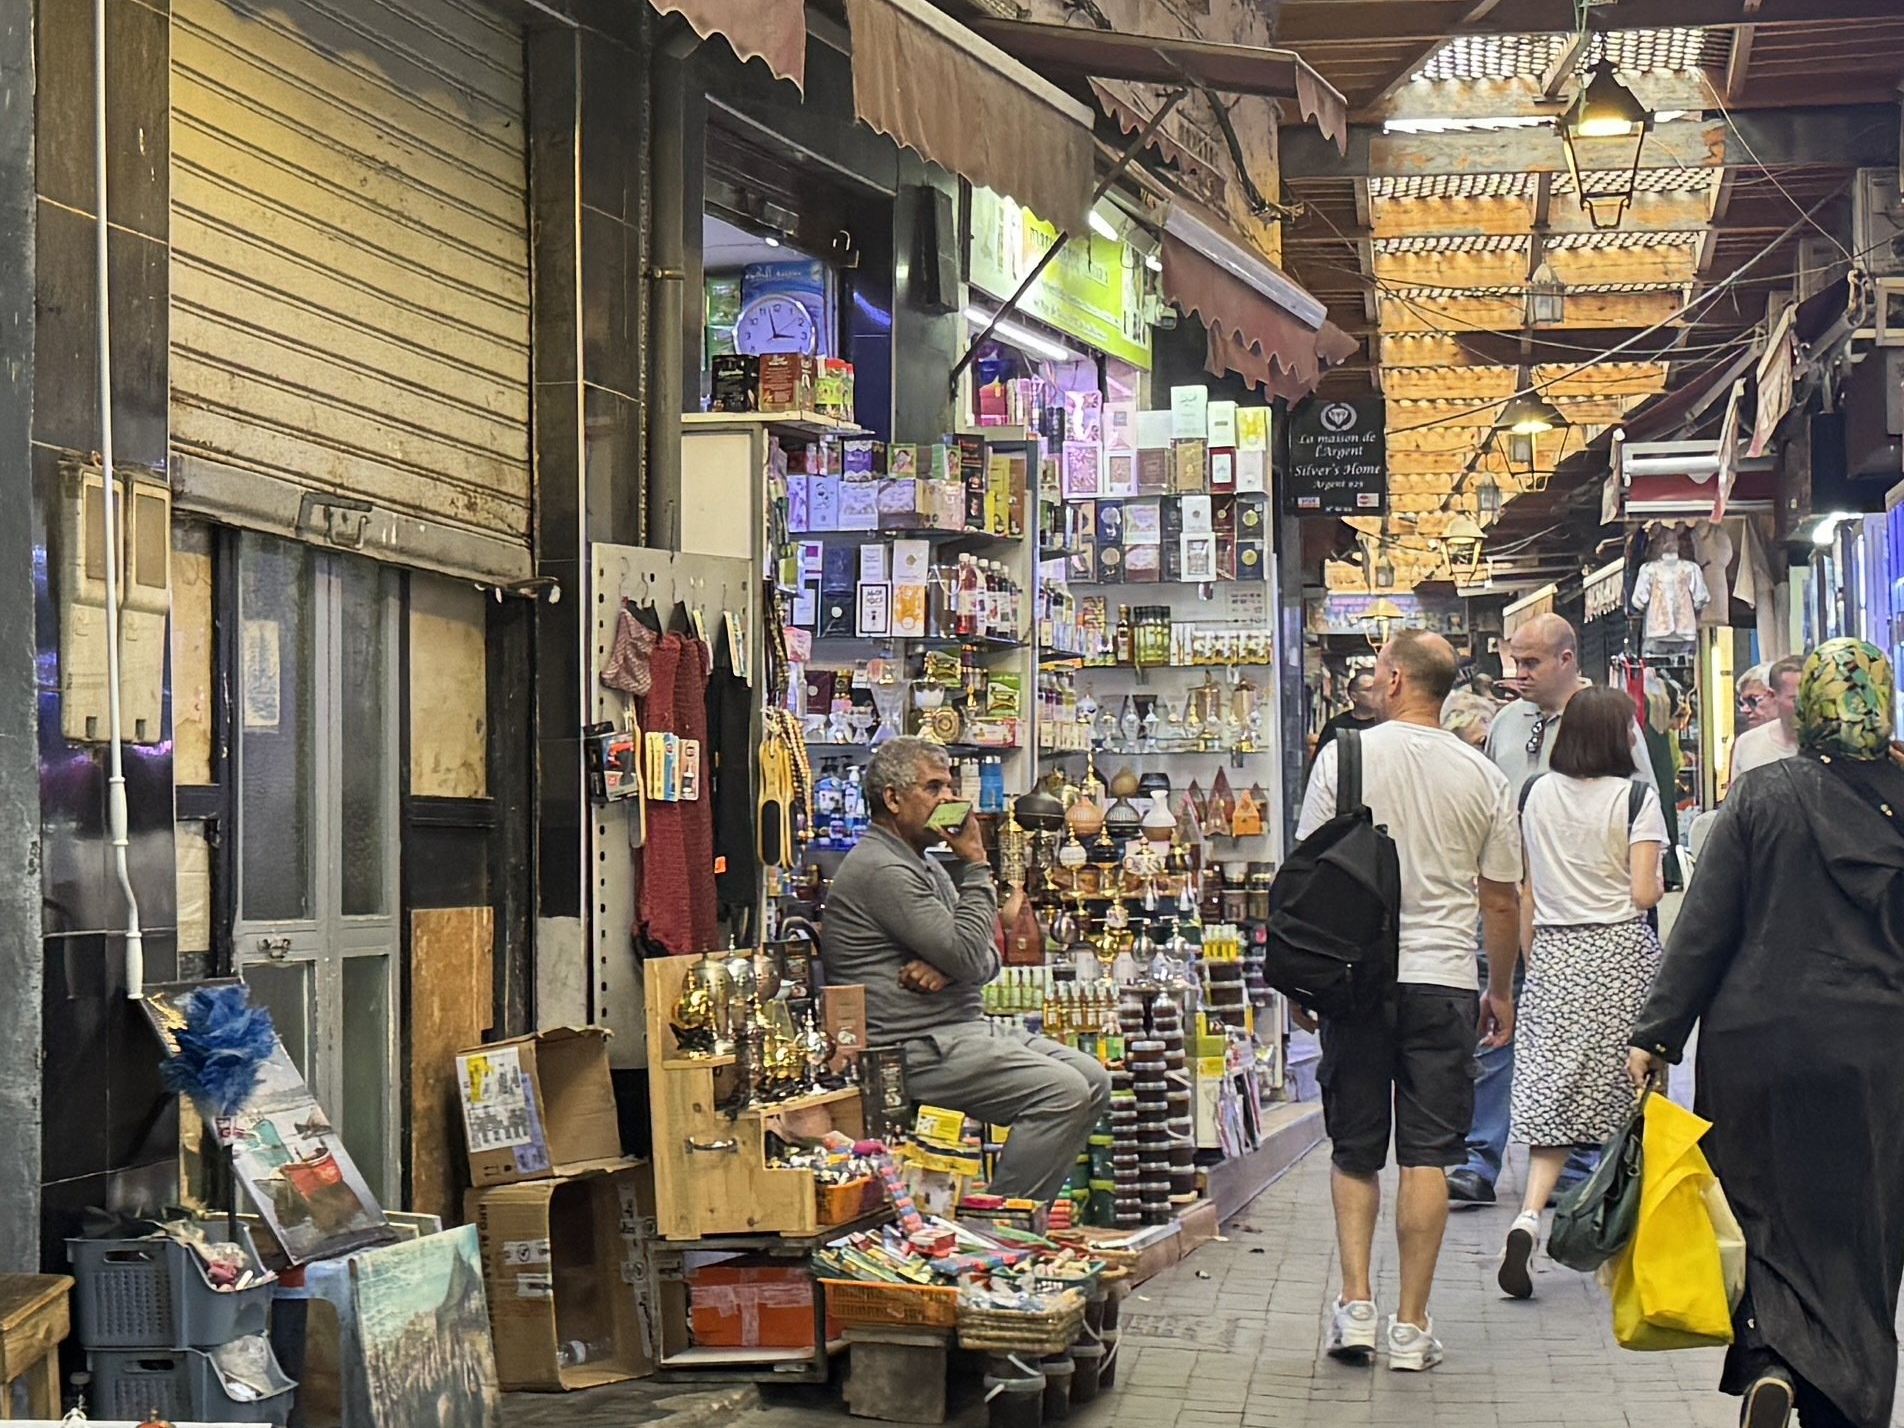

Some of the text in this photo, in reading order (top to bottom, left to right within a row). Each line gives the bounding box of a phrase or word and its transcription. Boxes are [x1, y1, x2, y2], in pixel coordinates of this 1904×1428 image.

[759, 307, 767, 315] 11
[798, 318, 805, 327] 2
[801, 331, 808, 340] 3
[1298, 431, 1376, 444] La maison de
[1294, 462, 1381, 477] Silver's Home
[1313, 480, 1346, 491] Argent
